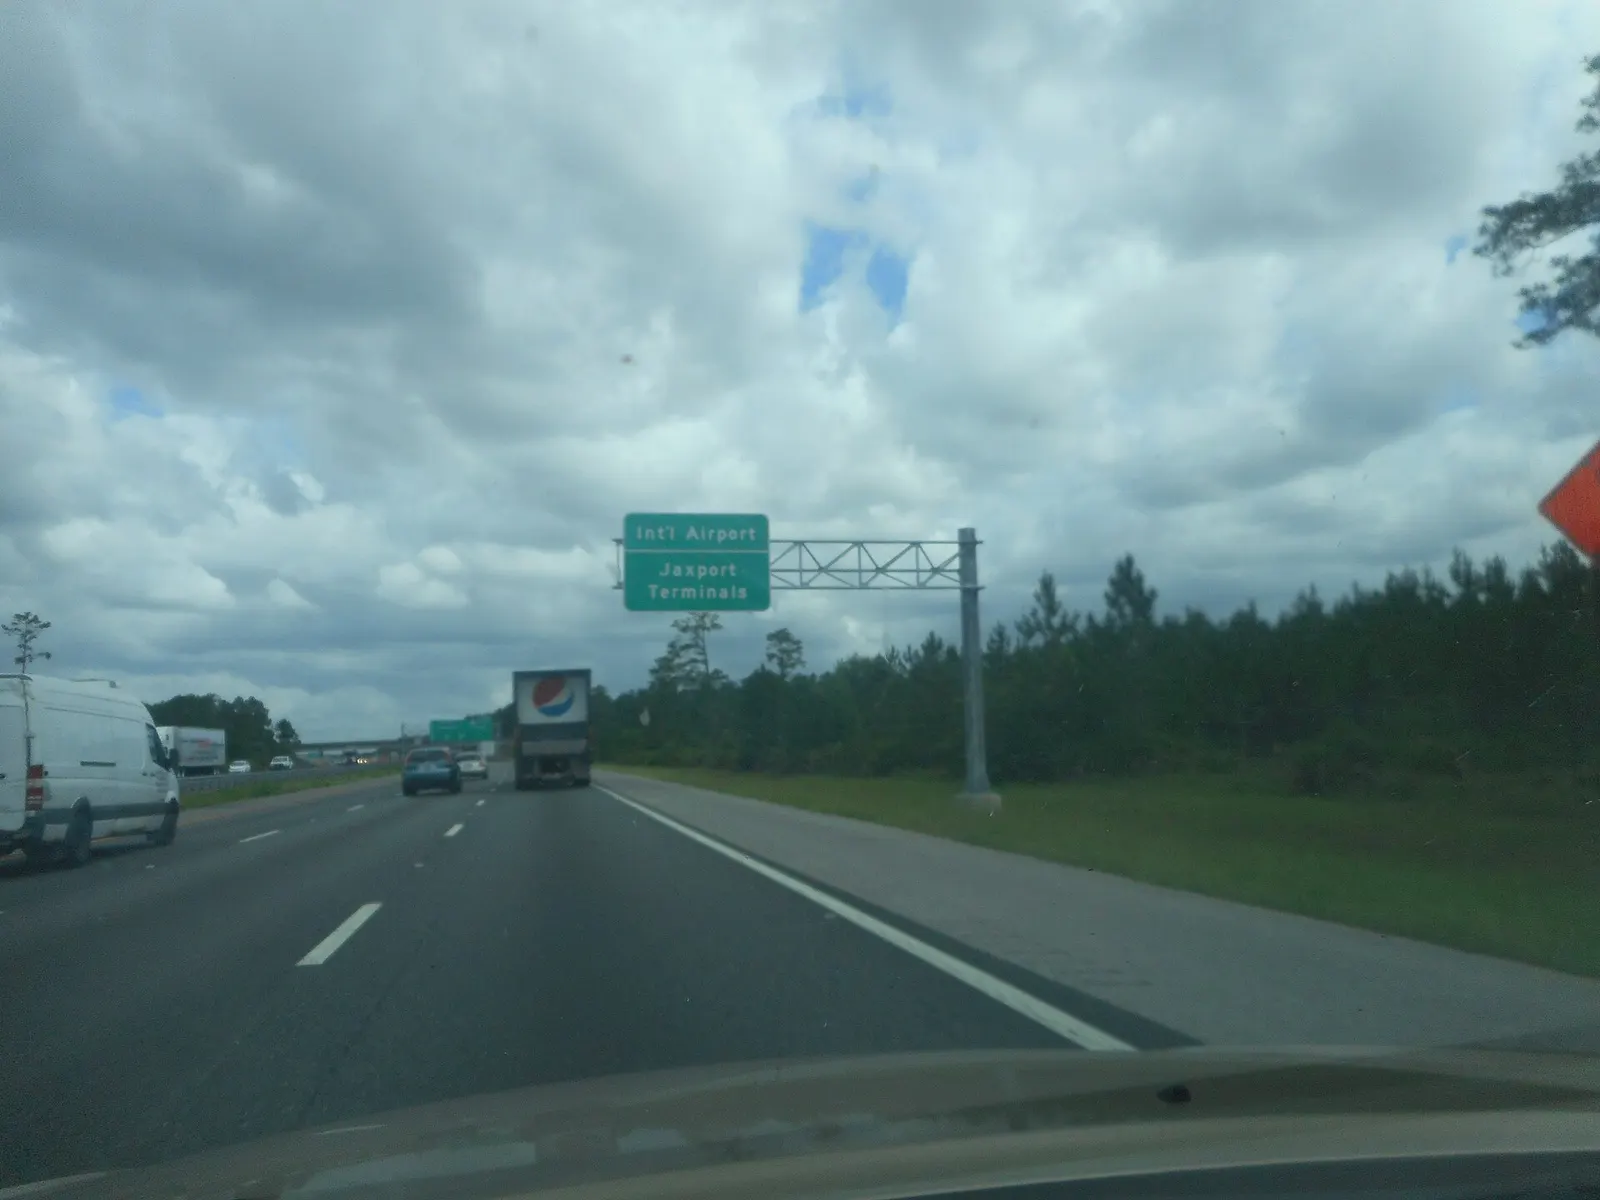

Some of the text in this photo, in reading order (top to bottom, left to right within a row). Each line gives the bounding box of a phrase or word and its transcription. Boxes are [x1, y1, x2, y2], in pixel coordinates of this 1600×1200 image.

[637, 526, 756, 543] Int'l Airport
[659, 562, 737, 579] Jaxport
[648, 584, 748, 599] Terminals
